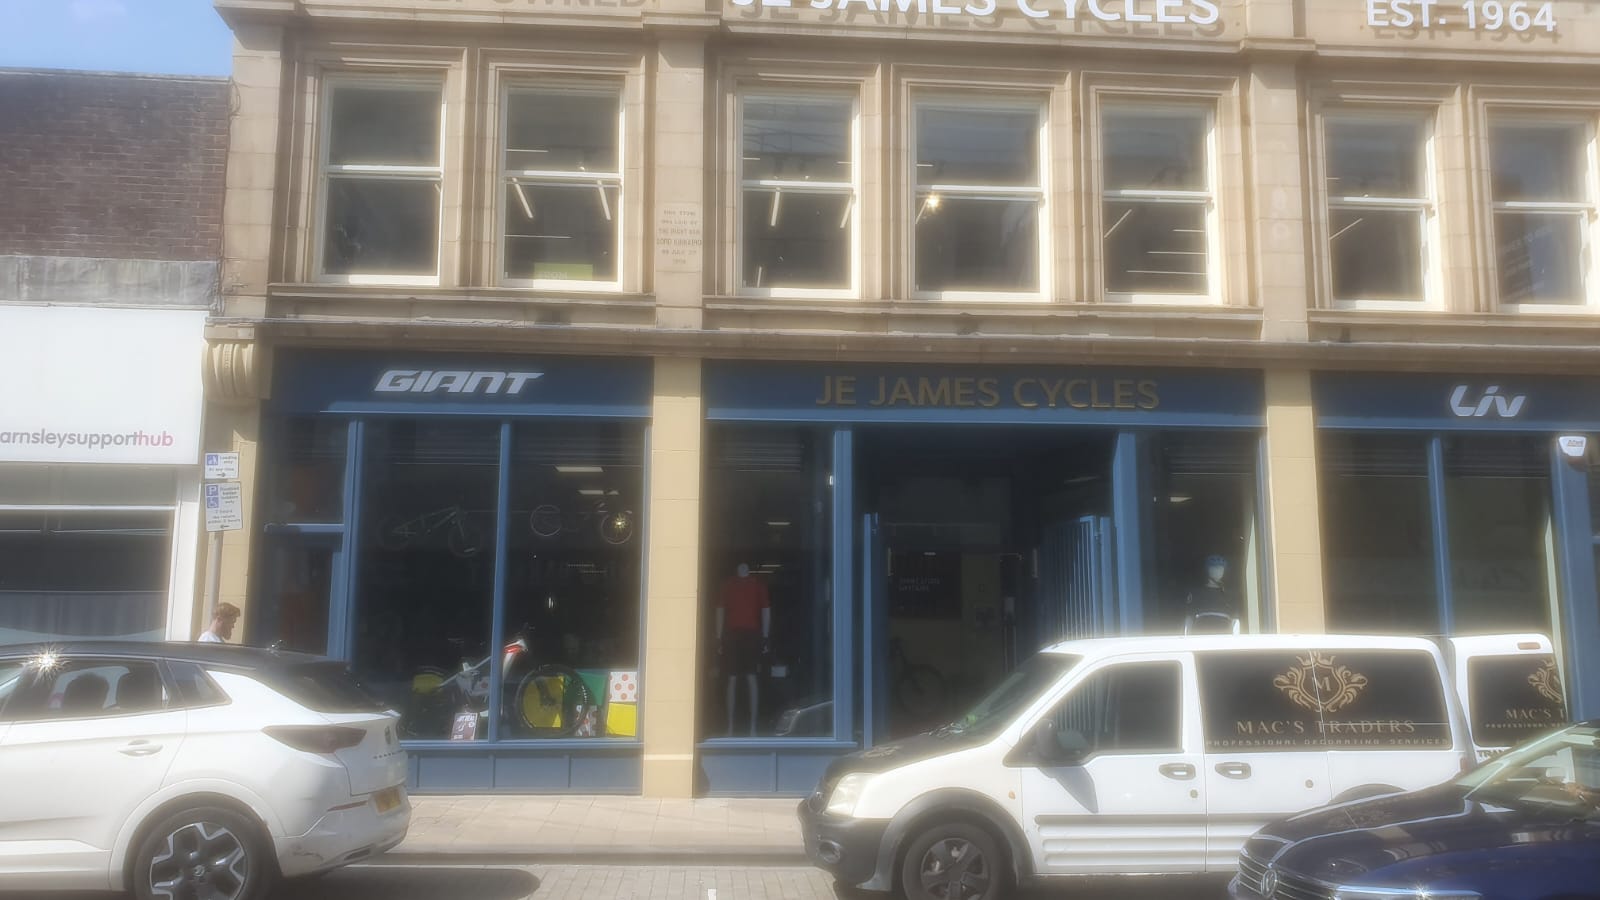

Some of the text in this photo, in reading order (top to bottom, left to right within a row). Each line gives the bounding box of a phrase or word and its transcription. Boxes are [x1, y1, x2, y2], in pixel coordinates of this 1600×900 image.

[1366, 0, 1557, 32] EST. 1964
[374, 370, 544, 393] GIANT
[816, 375, 1160, 410] JE JAMES CYCLES
[1450, 384, 1526, 417] Liv
[1237, 720, 1416, 734] MAC'S TRADERS
